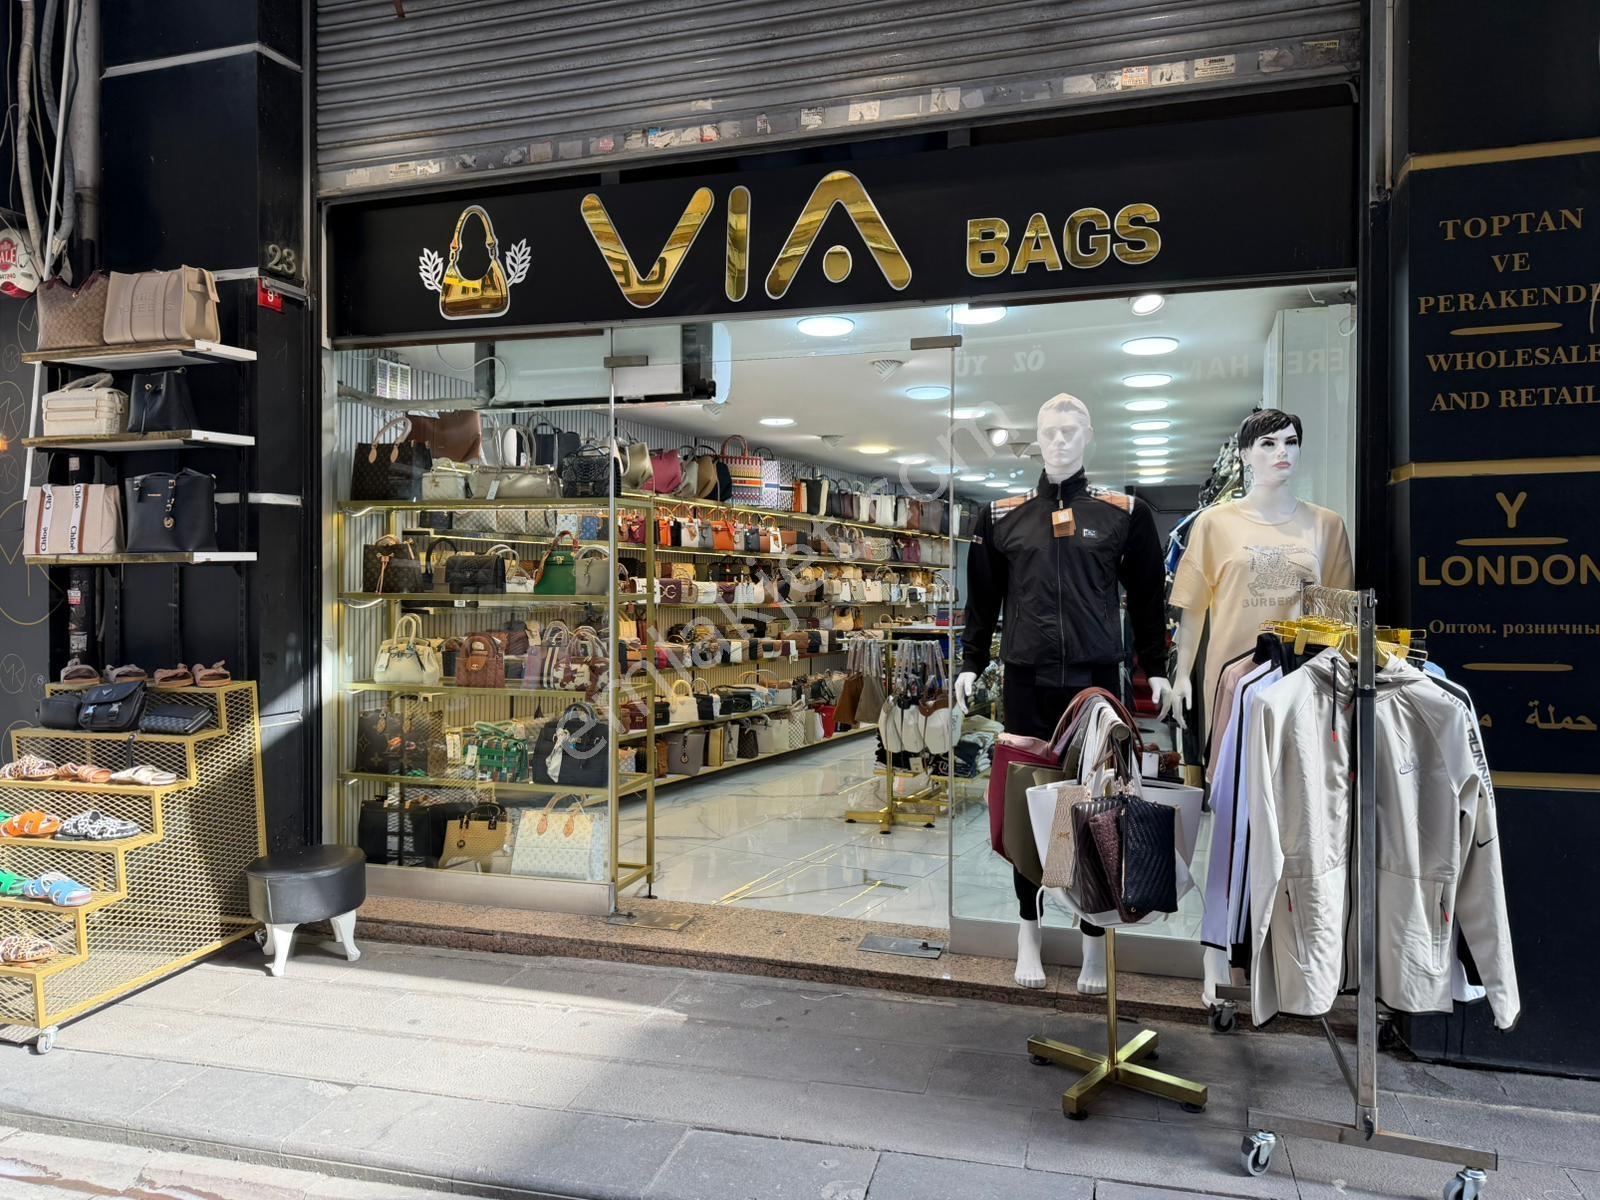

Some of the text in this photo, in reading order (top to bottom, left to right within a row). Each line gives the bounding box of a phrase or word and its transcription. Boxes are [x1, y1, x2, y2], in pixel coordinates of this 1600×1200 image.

[1439, 207, 1584, 241] TOPTAN
[580, 170, 1162, 309] VIA BAGS
[267, 244, 297, 273] 23
[1491, 252, 1531, 273] VE
[1425, 343, 1600, 372] WHOLESALE
[1429, 384, 1600, 412] AND RETAIL
[1495, 491, 1528, 529] Y
[1418, 554, 1600, 586] LONDON
[1429, 619, 1497, 634] Оптом.
